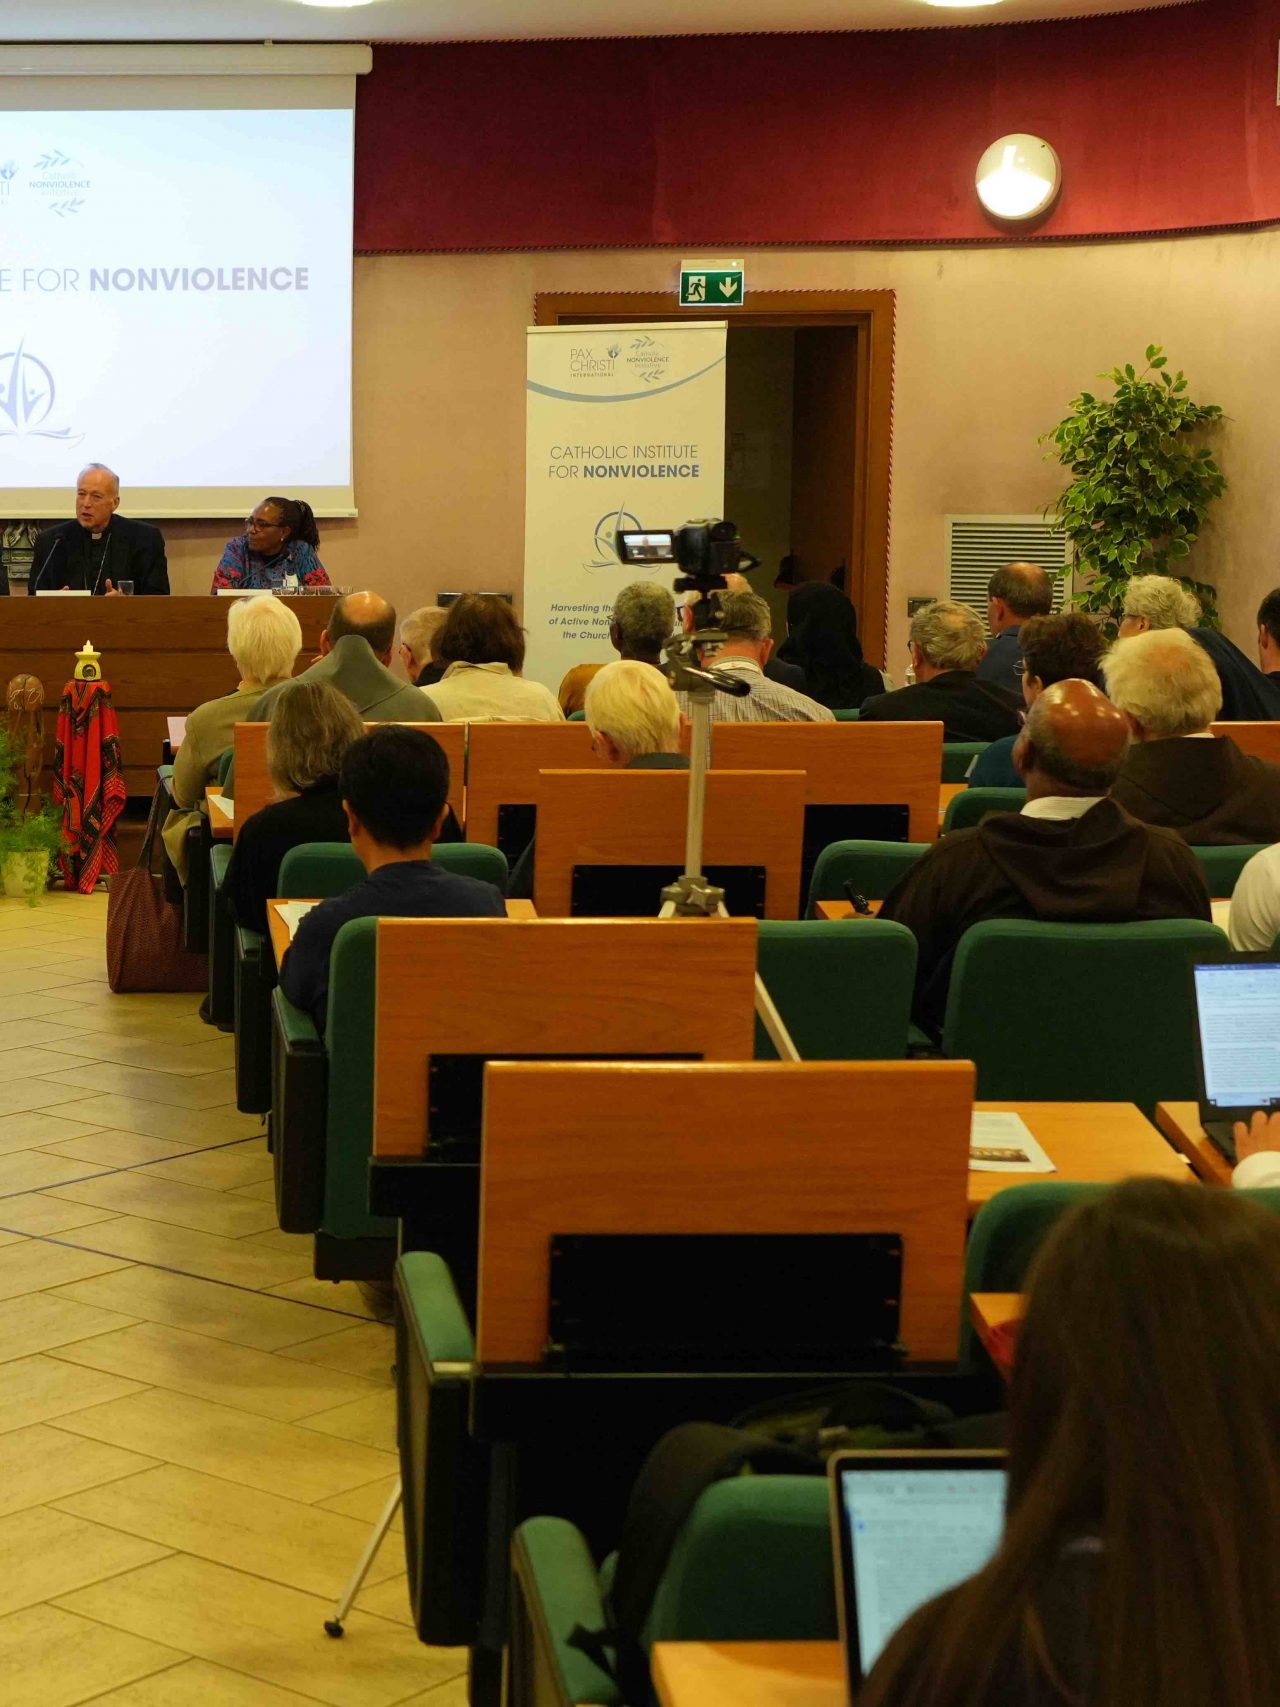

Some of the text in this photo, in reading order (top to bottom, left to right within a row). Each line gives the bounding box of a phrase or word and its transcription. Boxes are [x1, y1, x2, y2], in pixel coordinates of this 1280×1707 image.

[29, 180, 91, 188] NONVIOLENCE
[23, 268, 80, 292] FOR
[90, 267, 309, 291] NONVIOLENCE
[570, 348, 593, 360] PAX
[570, 359, 615, 372] CHRISTI
[550, 444, 699, 459] CATHOLIC INSTITUTE
[548, 464, 700, 479] FOR NONVIOLENCE
[550, 603, 600, 614] Harvesting
[548, 617, 559, 625] of
[560, 617, 589, 626] Active
[562, 631, 577, 639] the
